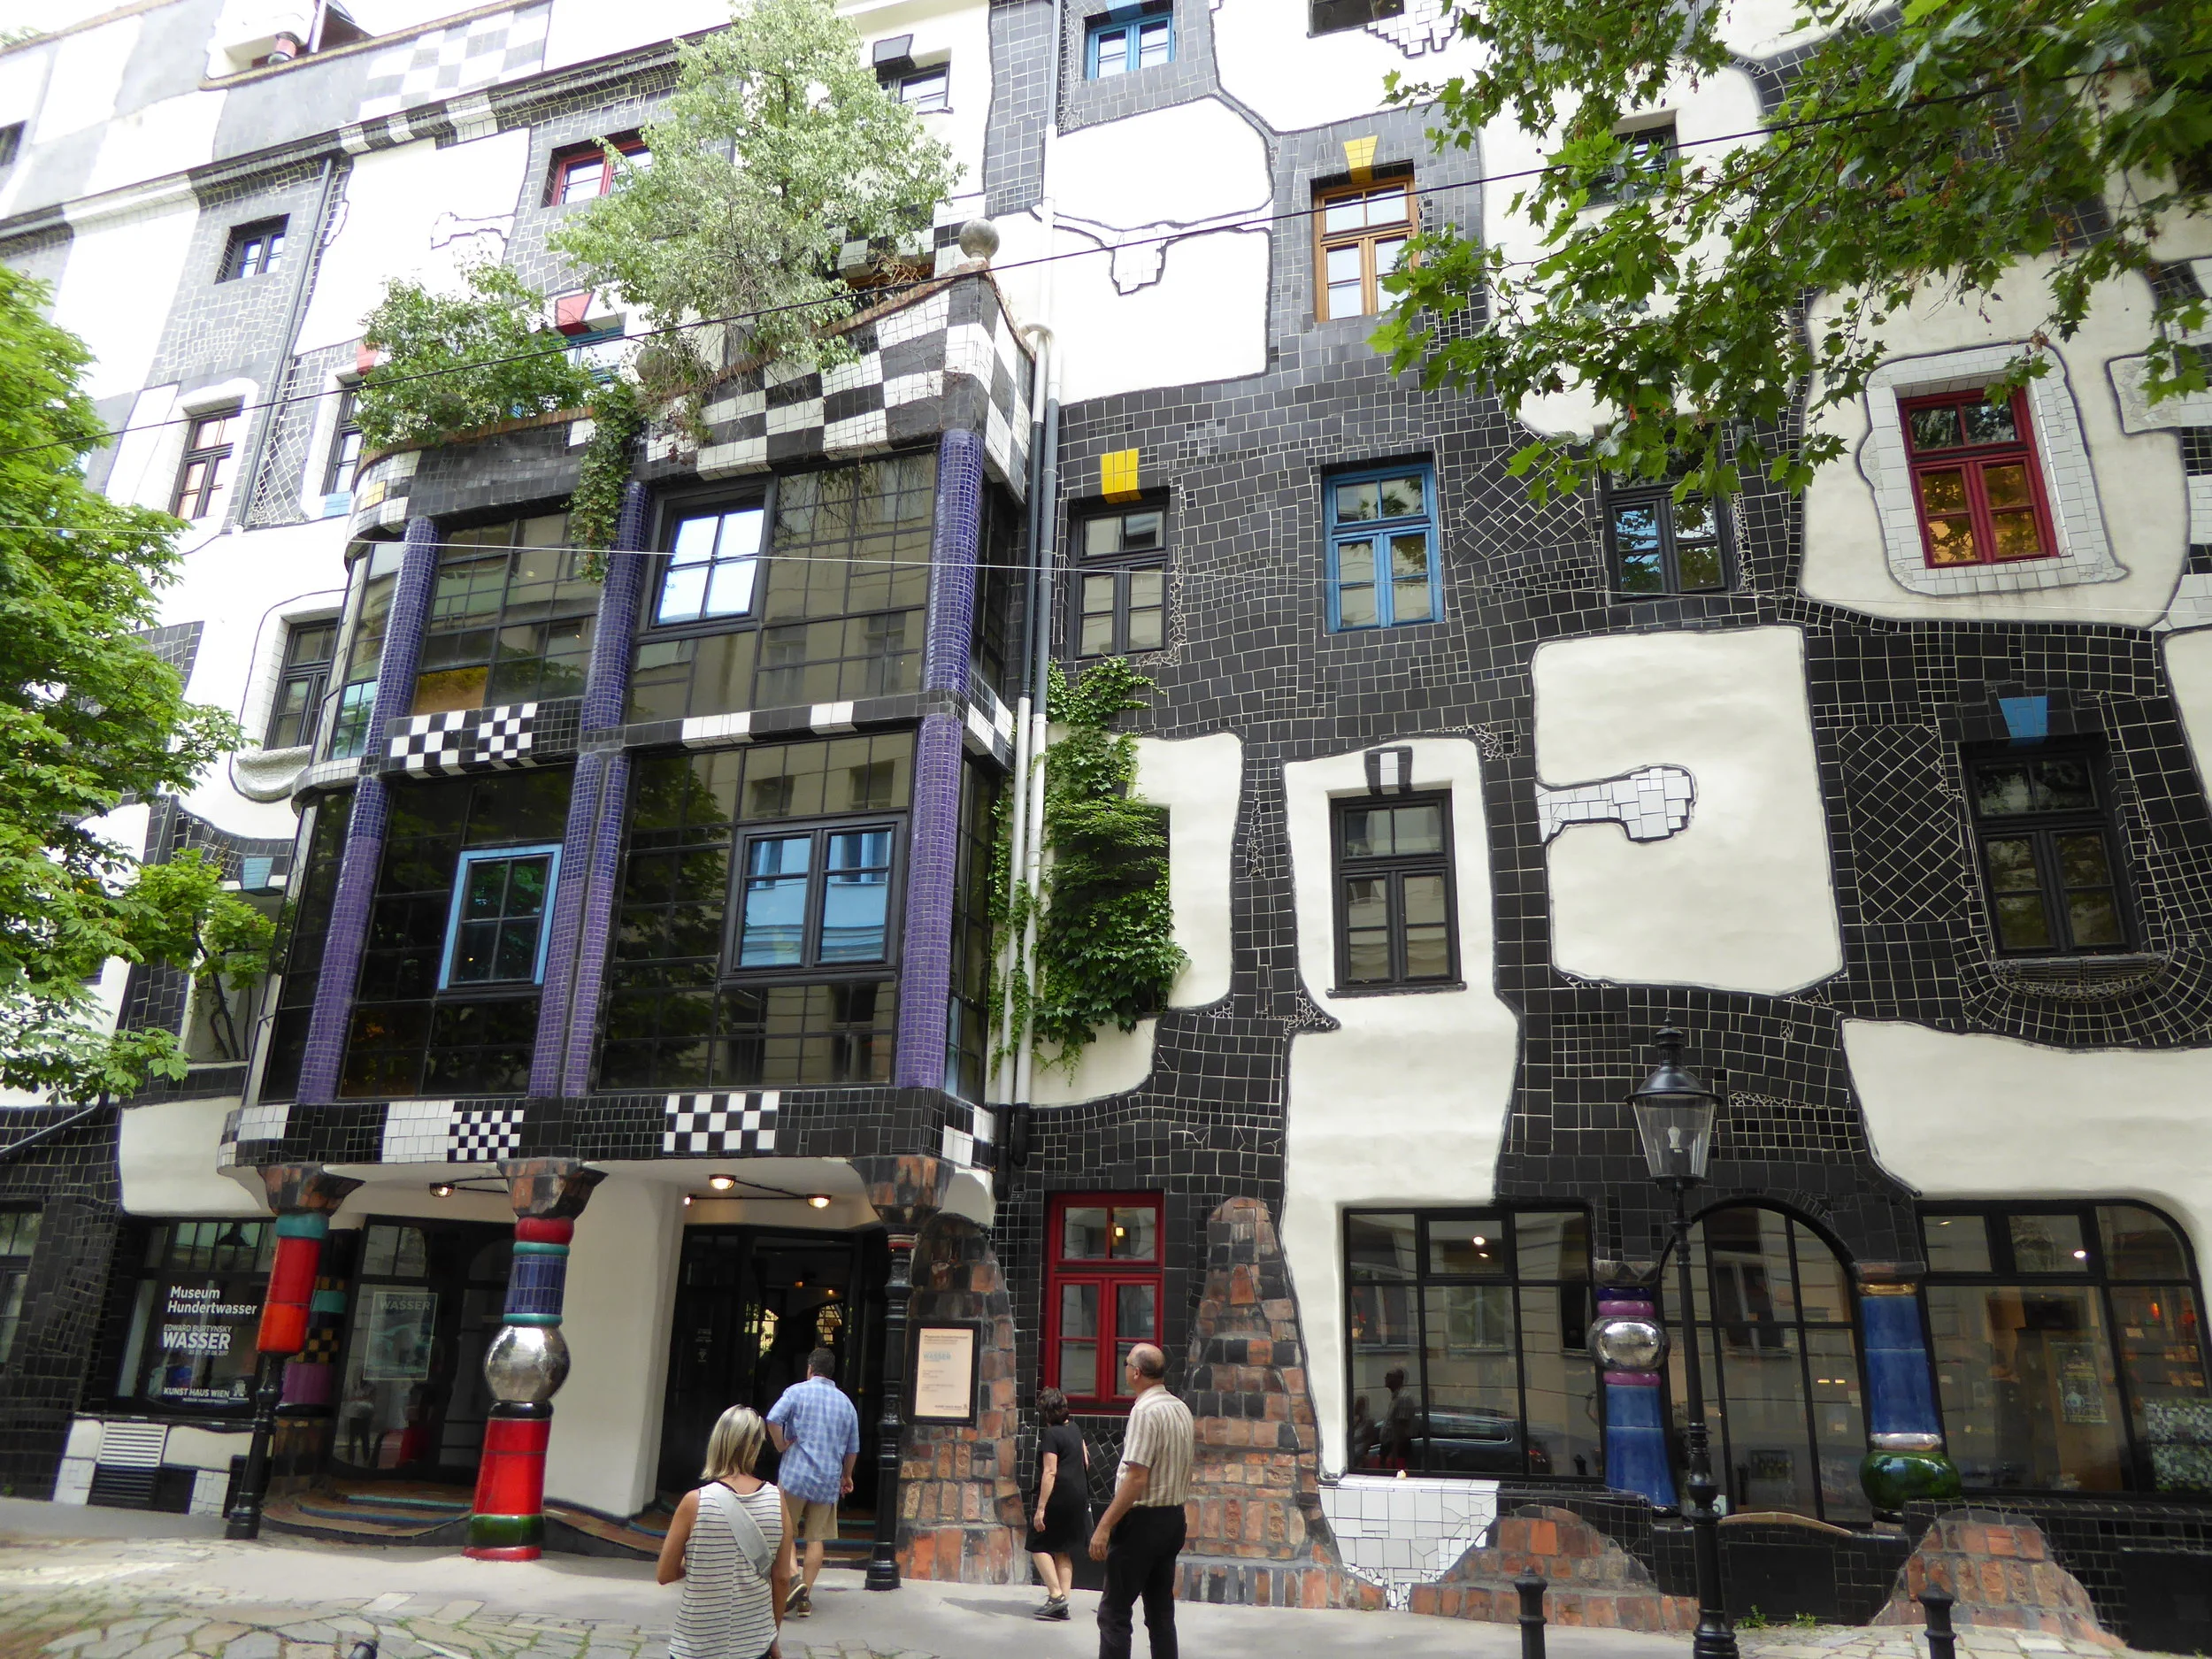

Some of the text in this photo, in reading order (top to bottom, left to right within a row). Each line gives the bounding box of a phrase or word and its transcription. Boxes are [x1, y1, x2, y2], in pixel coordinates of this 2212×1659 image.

[170, 1286, 220, 1299] Museum
[167, 1300, 257, 1315] Hundertwasser
[380, 1301, 431, 1310] WASSER
[163, 1332, 231, 1349] WASSER
[163, 1386, 230, 1398] KUNST HAUS WIEN
